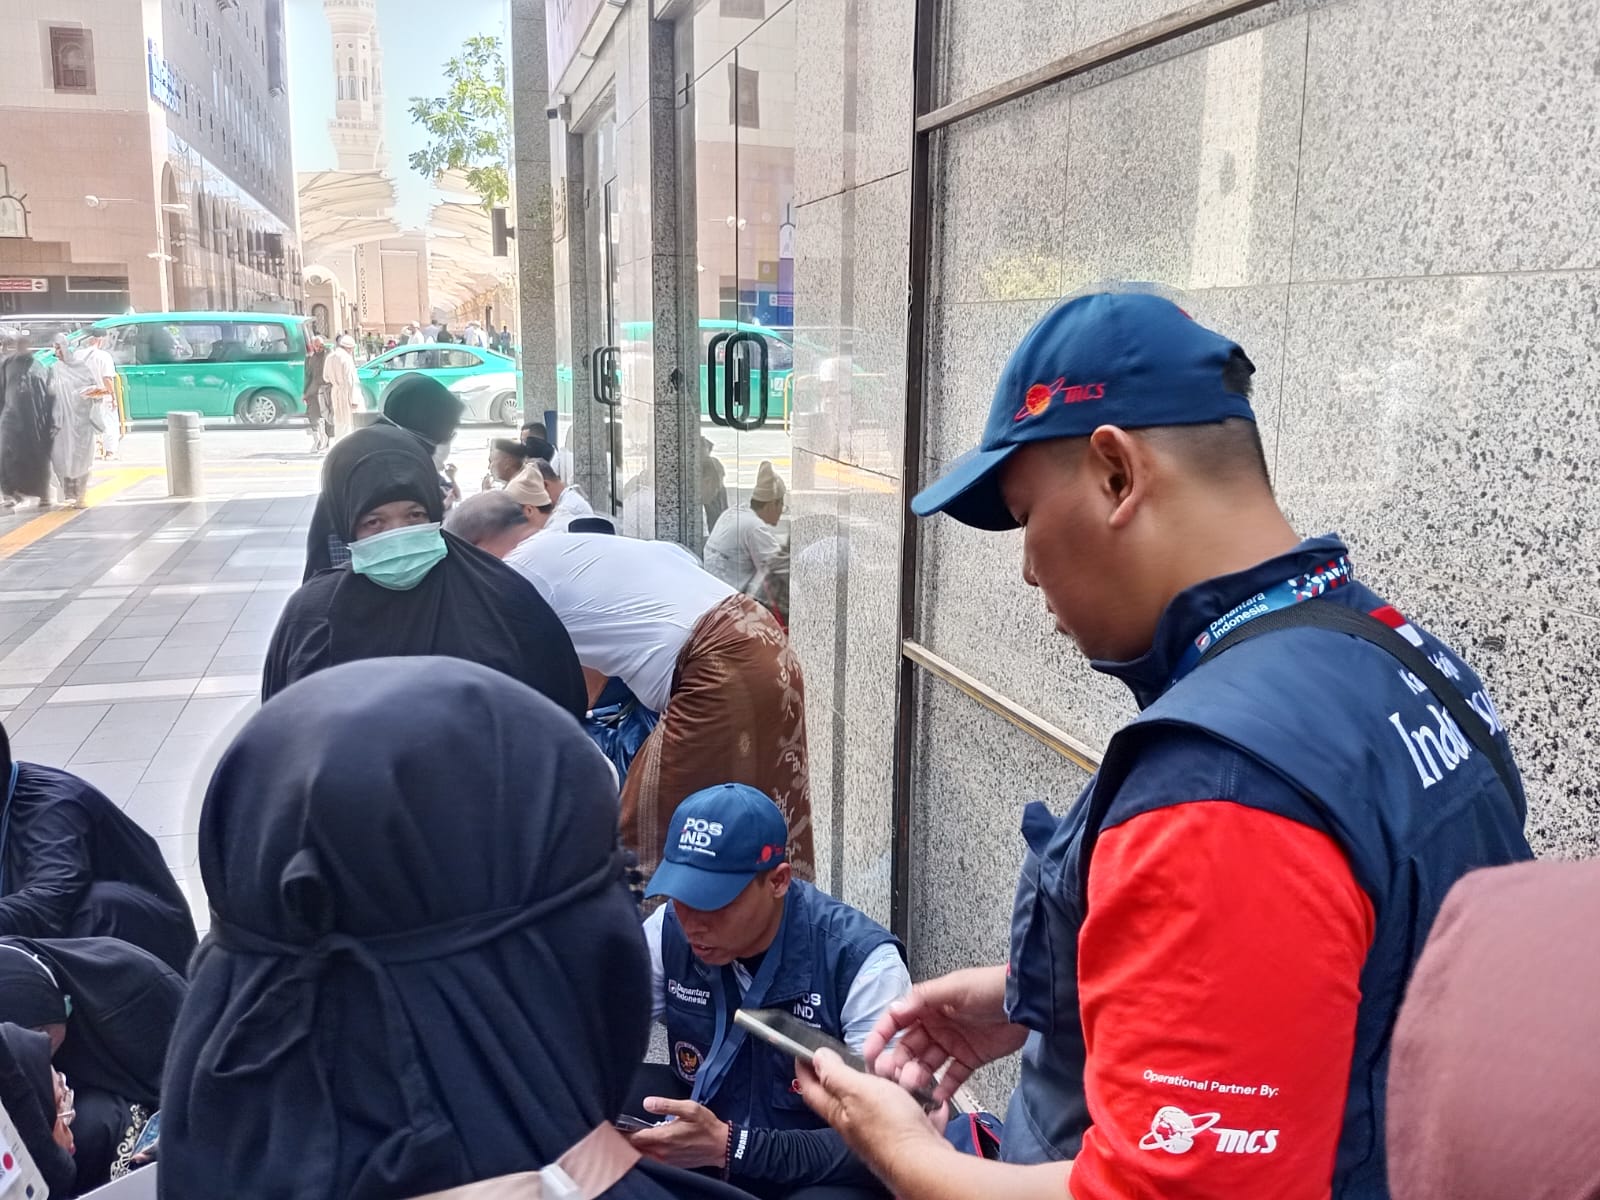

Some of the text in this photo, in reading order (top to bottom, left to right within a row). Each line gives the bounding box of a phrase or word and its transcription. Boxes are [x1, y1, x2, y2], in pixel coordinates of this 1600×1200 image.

[1209, 592, 1266, 631] Danantara
[683, 817, 723, 836] POS
[1143, 1069, 1280, 1098] Operational Partner By:
